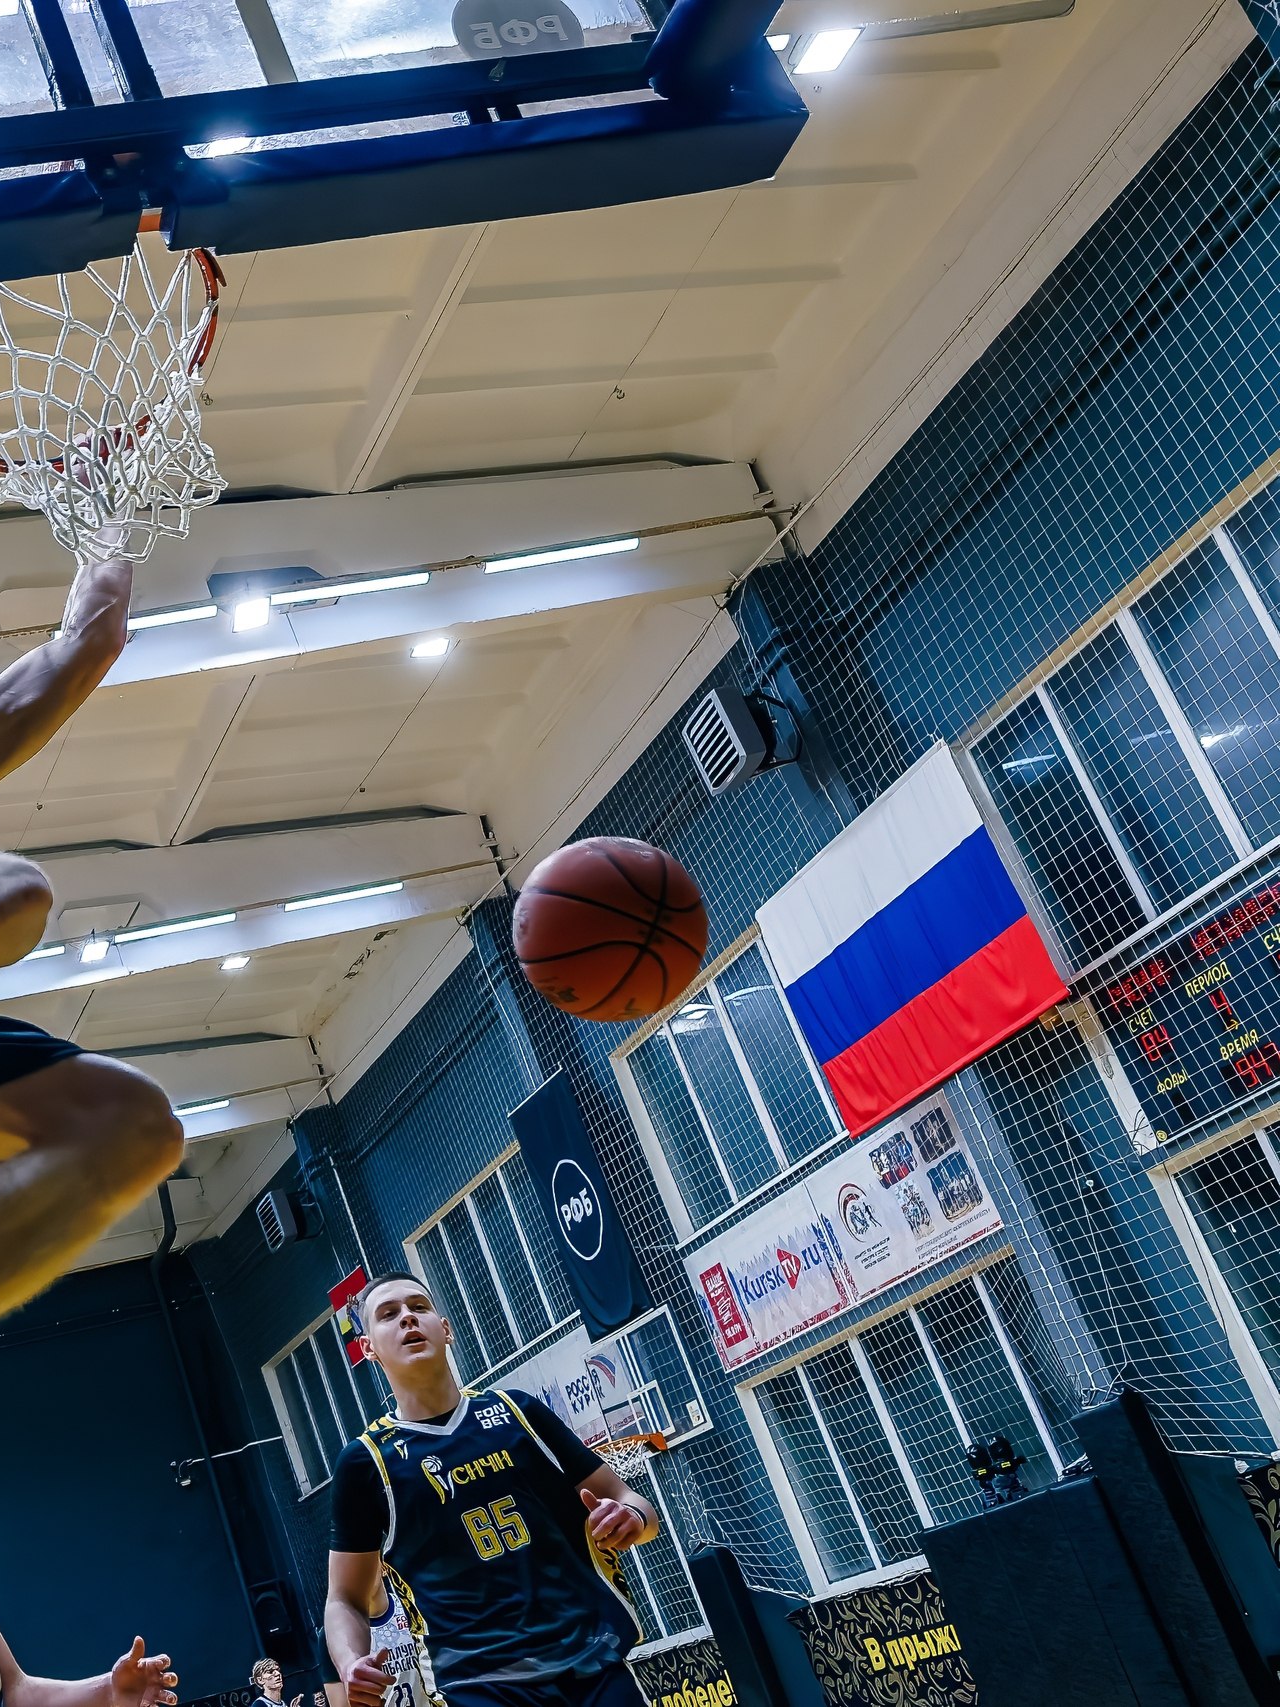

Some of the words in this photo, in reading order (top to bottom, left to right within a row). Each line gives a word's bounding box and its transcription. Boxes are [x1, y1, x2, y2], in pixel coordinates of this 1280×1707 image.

[1185, 961, 1231, 998] ПЕРИОД
[1220, 1029, 1259, 1060] ВРЕМЯ
[565, 1369, 602, 1400] РОССЯ
[474, 1402, 506, 1420] FON
[480, 1412, 511, 1430] BET
[461, 1495, 531, 1560] 65
